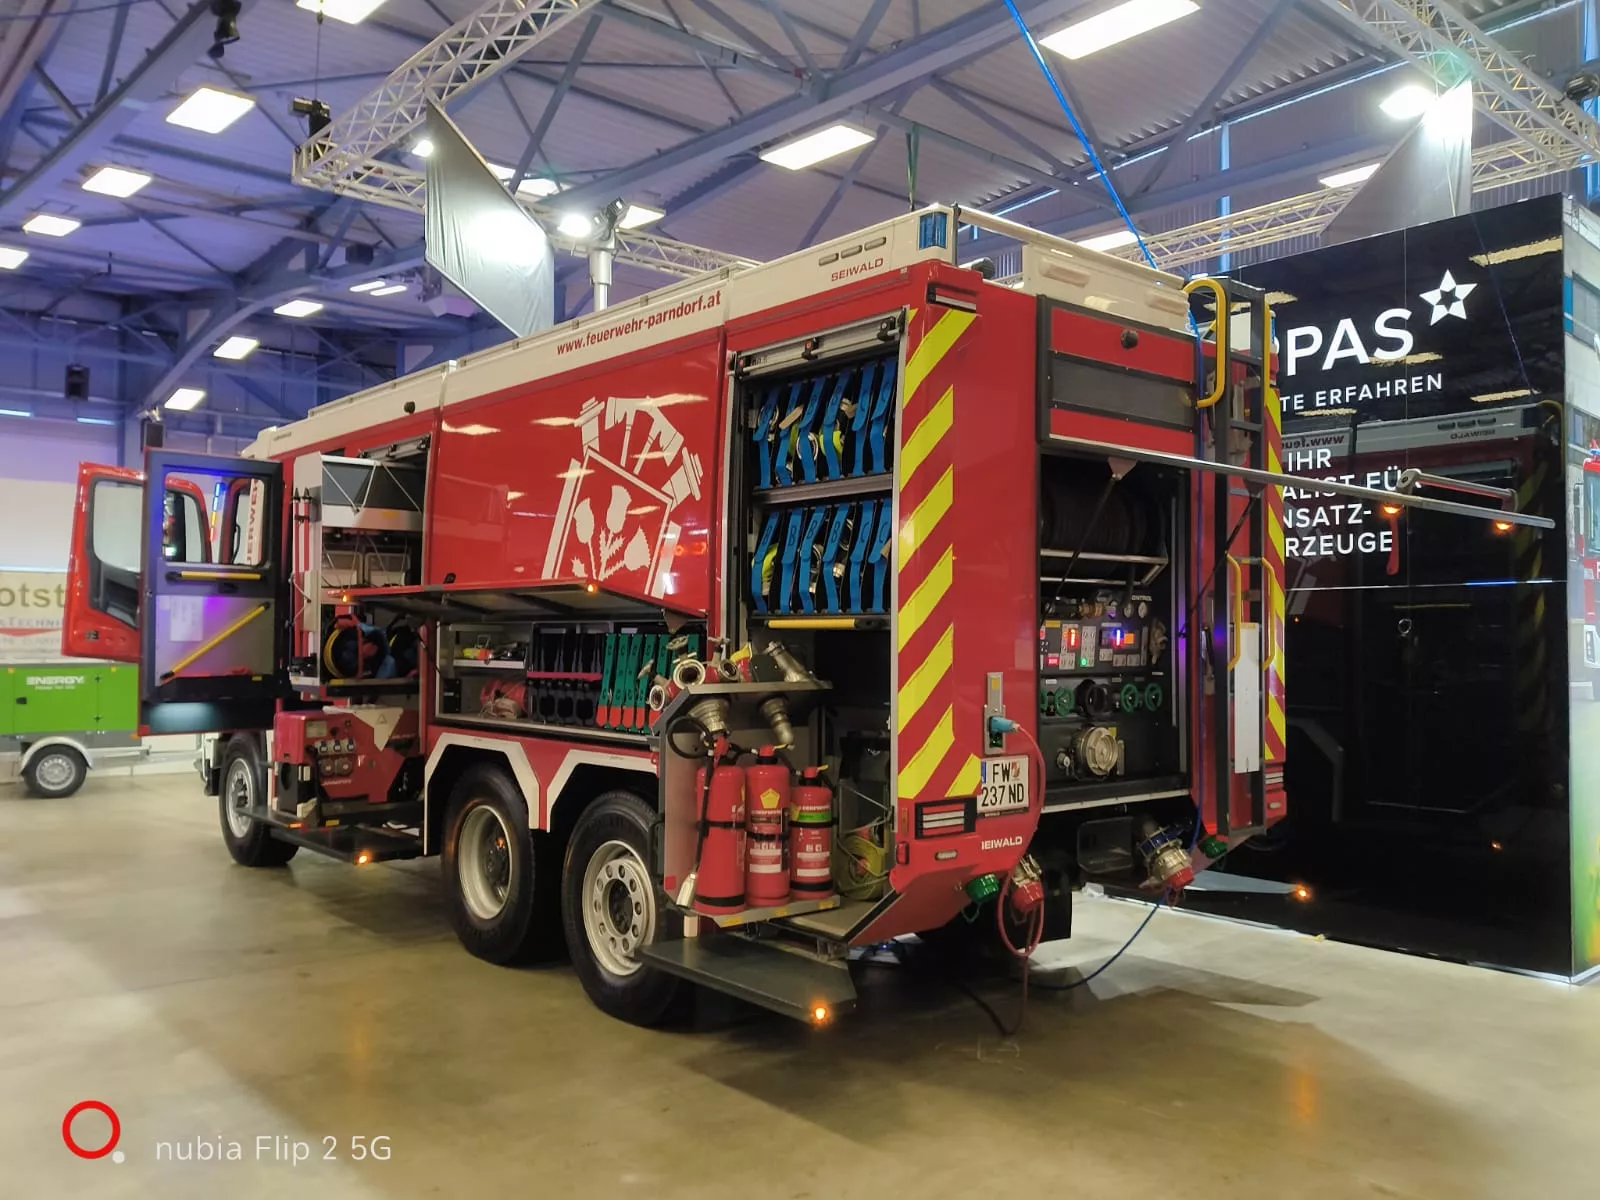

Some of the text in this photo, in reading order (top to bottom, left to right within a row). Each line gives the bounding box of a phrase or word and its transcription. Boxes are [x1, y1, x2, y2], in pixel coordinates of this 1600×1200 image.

[831, 257, 884, 282] SEIWALD
[556, 289, 721, 356] www.feuerwehr-parndorf.at
[1274, 308, 1415, 377] PAS
[1315, 373, 1443, 407] ERFAHREN
[1288, 448, 1332, 472] IHR
[1366, 465, 1422, 492] FÜ
[1285, 530, 1393, 558] RZEUGE
[992, 762, 1011, 783] FW
[981, 783, 1025, 808] 237 ND
